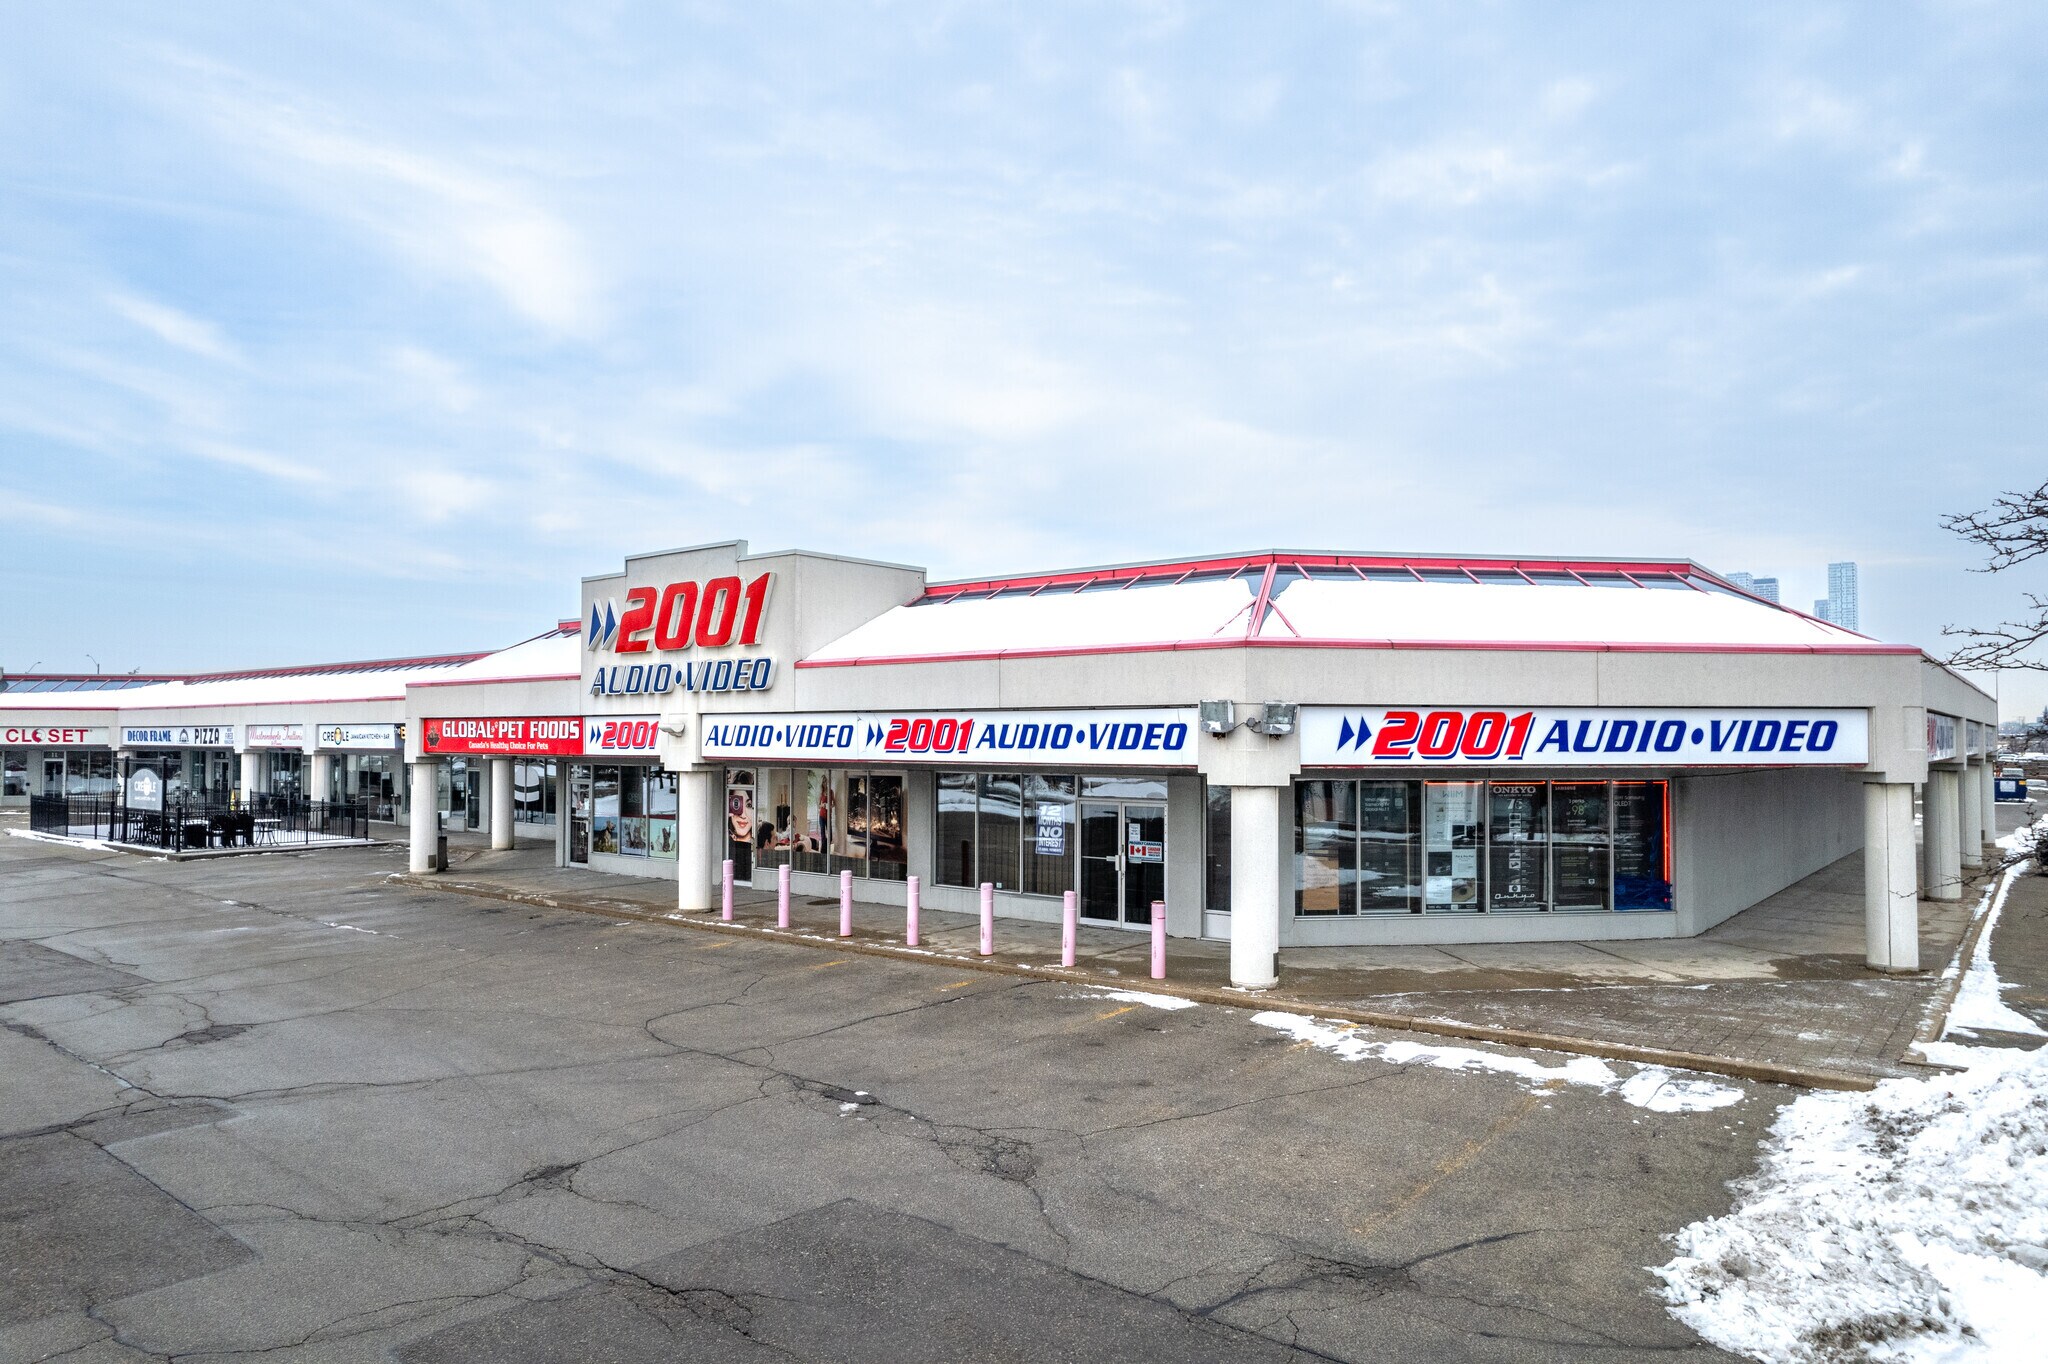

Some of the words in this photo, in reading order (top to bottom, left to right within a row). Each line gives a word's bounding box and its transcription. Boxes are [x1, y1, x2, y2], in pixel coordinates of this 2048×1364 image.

[615, 572, 776, 653] 2001
[127, 730, 148, 742] DECOR
[150, 730, 172, 742] FRAME
[194, 728, 220, 744] PIZZA
[442, 721, 494, 738] GLOBAL
[498, 721, 526, 739] PET
[530, 720, 580, 740] FOODS
[601, 721, 659, 750] 2001
[884, 718, 974, 753] 2001
[1370, 711, 1536, 760] 2001
[468, 741, 490, 749] Canada's
[490, 741, 509, 751] Healthy
[509, 742, 527, 750] Choice
[527, 742, 537, 750] For
[537, 742, 549, 750] Pets
[1493, 786, 1536, 794] ONKYO
[1038, 805, 1062, 816] 12
[1038, 815, 1062, 826] MONTHS
[1039, 826, 1063, 838] NO
[1038, 837, 1062, 848] INTEREST
